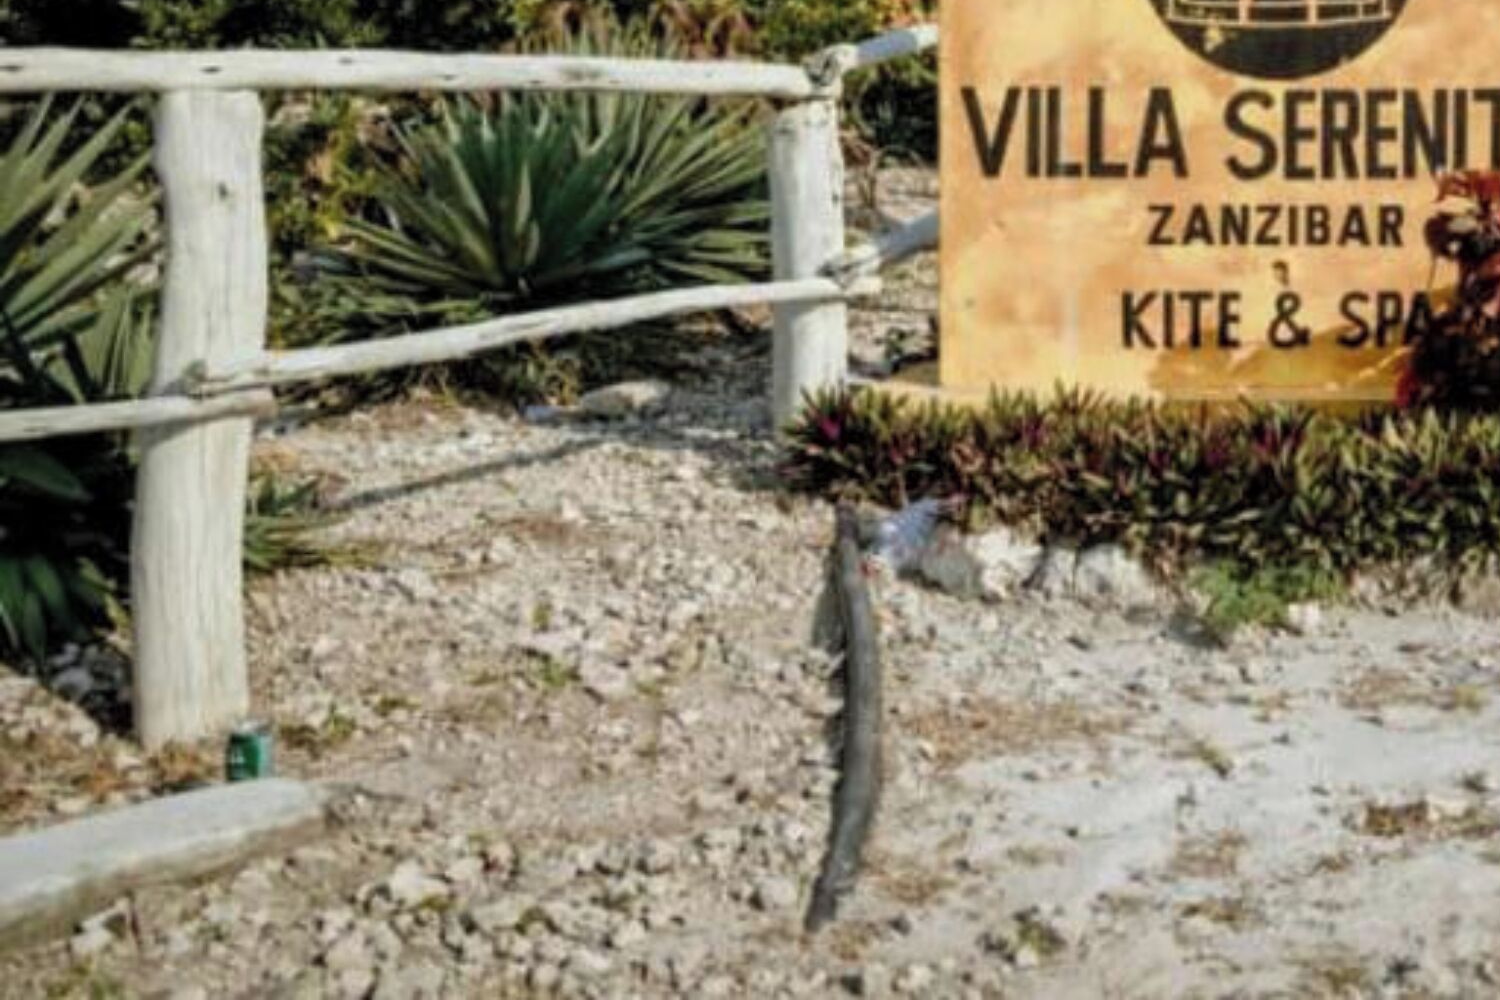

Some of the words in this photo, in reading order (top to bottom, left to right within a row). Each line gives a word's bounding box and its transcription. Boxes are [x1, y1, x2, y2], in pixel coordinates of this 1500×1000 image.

[961, 86, 1188, 178] VILLA
[1147, 204, 1404, 246] ZANZIBAR
[1121, 291, 1241, 349] KITE
[1268, 291, 1311, 348] &
